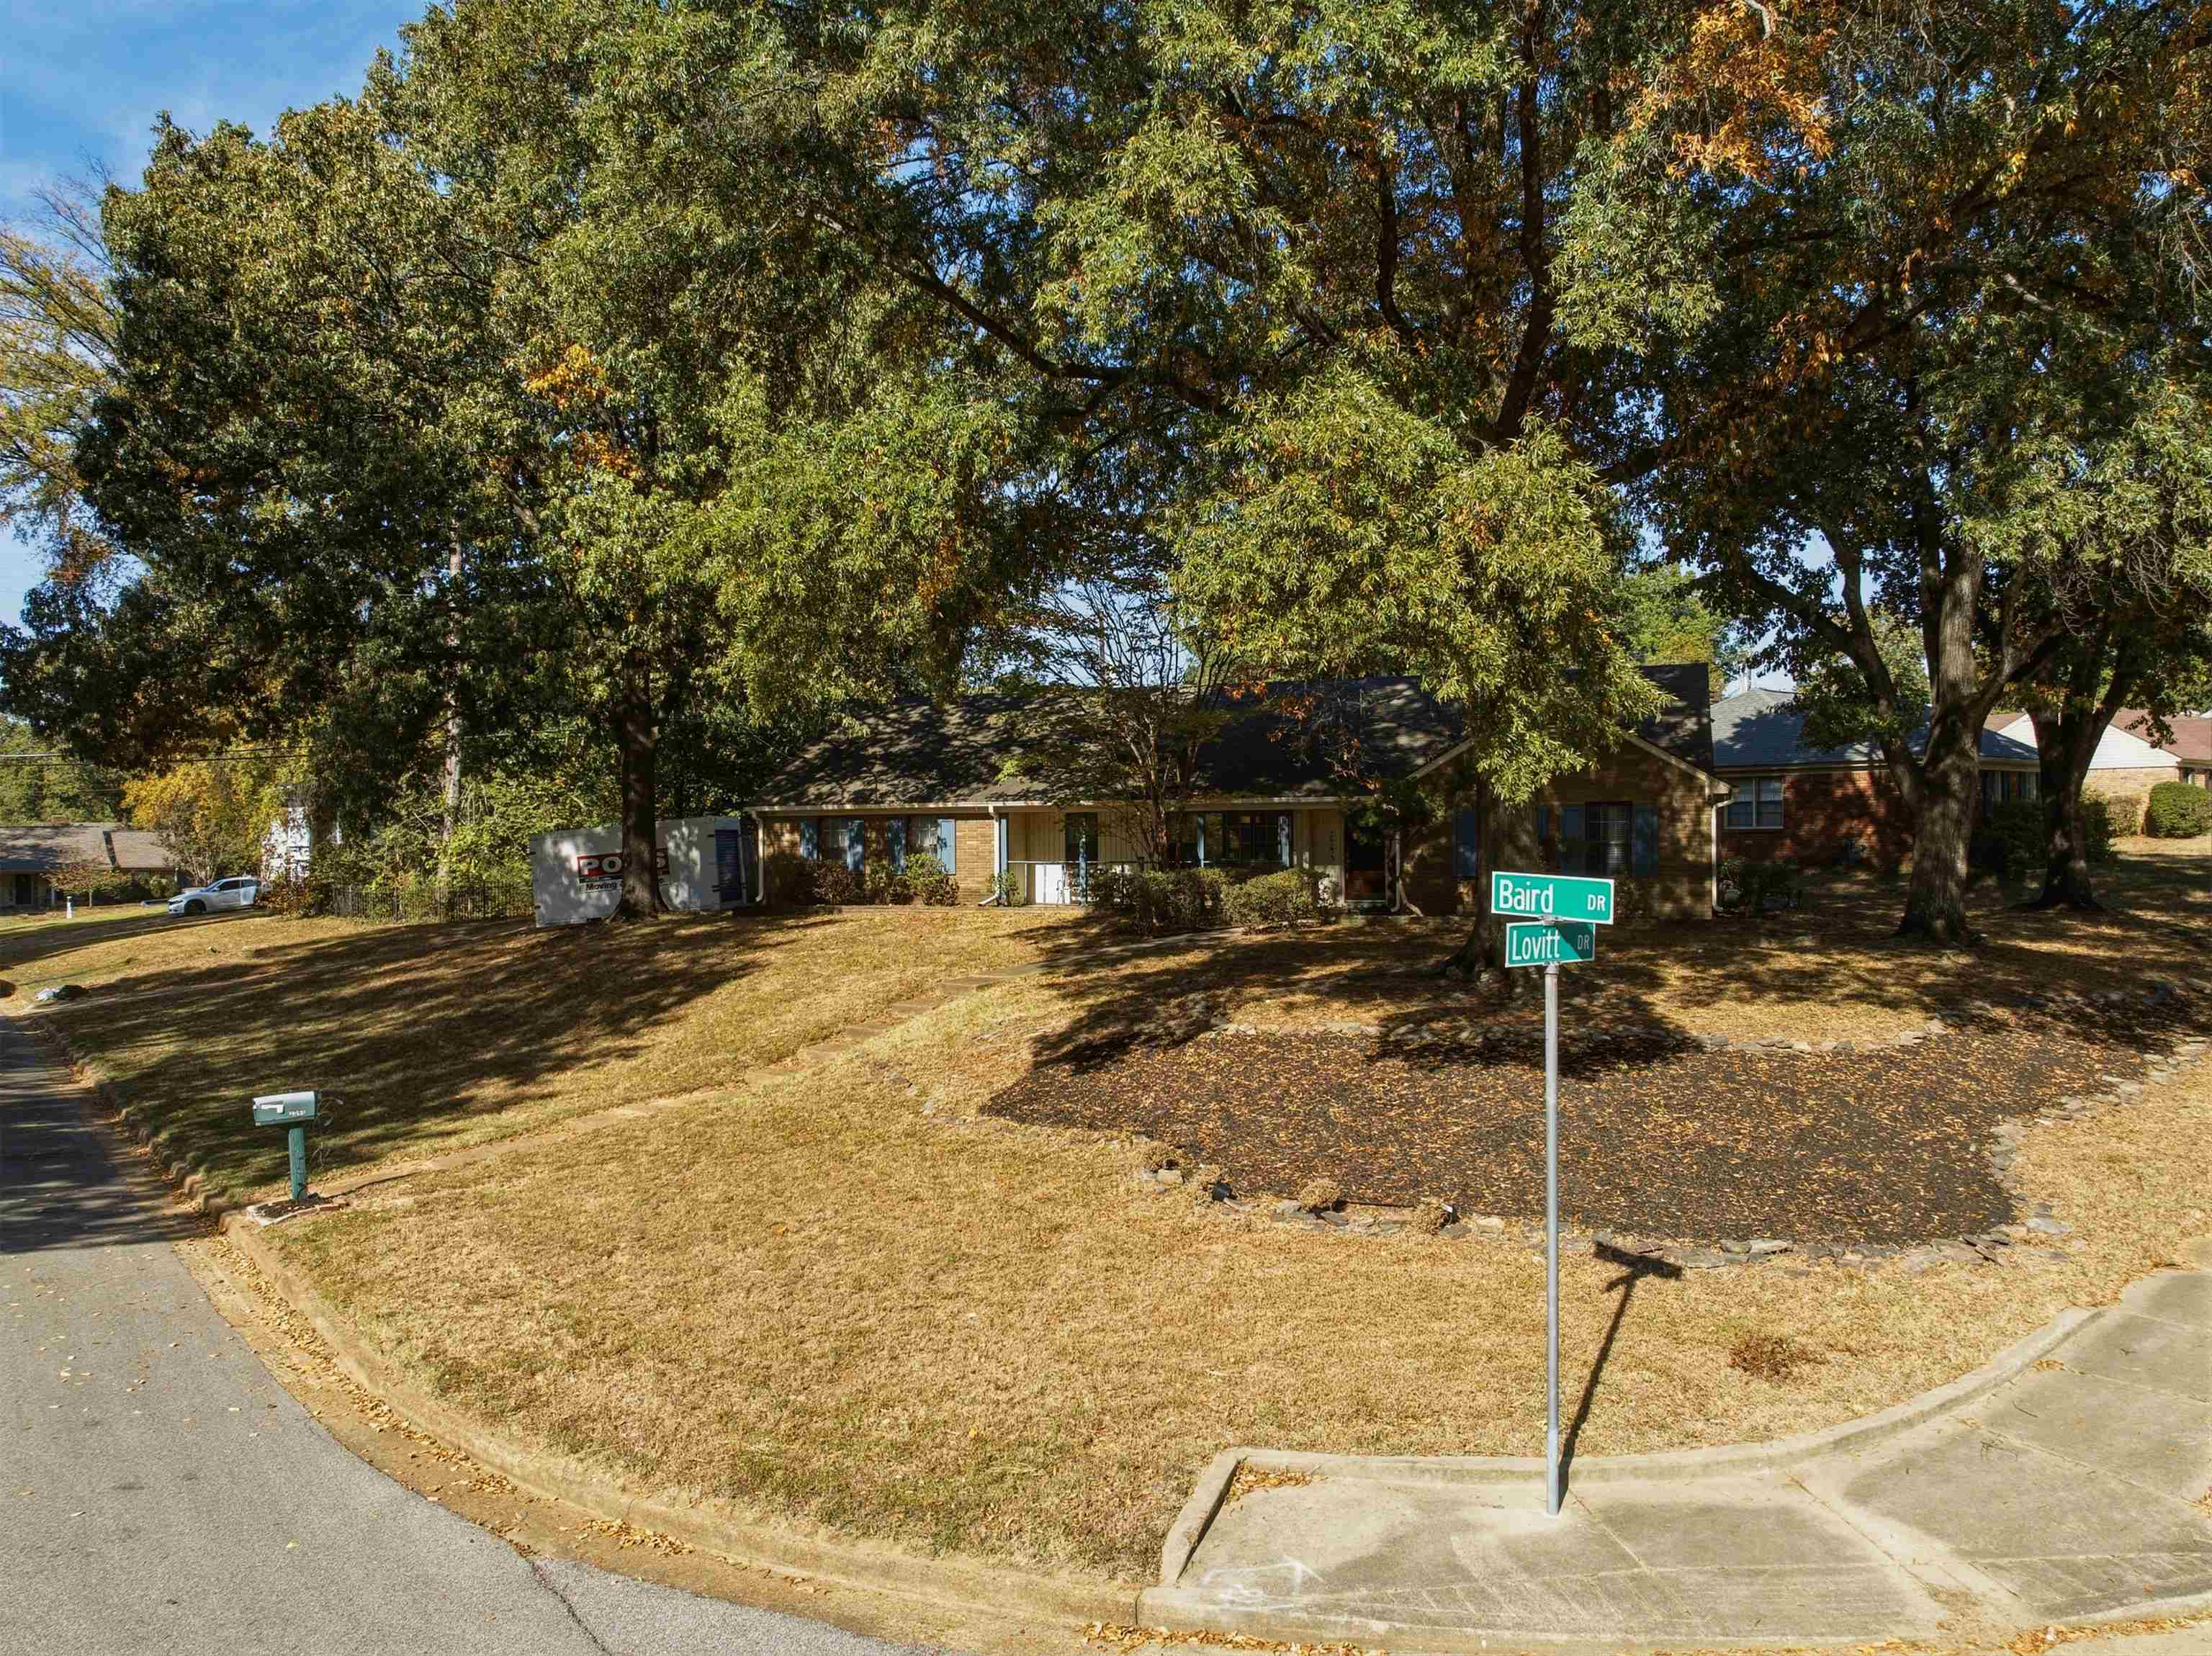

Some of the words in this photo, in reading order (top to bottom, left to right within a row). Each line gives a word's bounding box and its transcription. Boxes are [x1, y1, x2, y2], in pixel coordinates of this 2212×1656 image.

[586, 882, 617, 891] Moving
[1499, 879, 1553, 913] Baird
[1587, 894, 1606, 912] DR
[1512, 929, 1560, 960] Lovitt
[1578, 935, 1590, 950] DR
